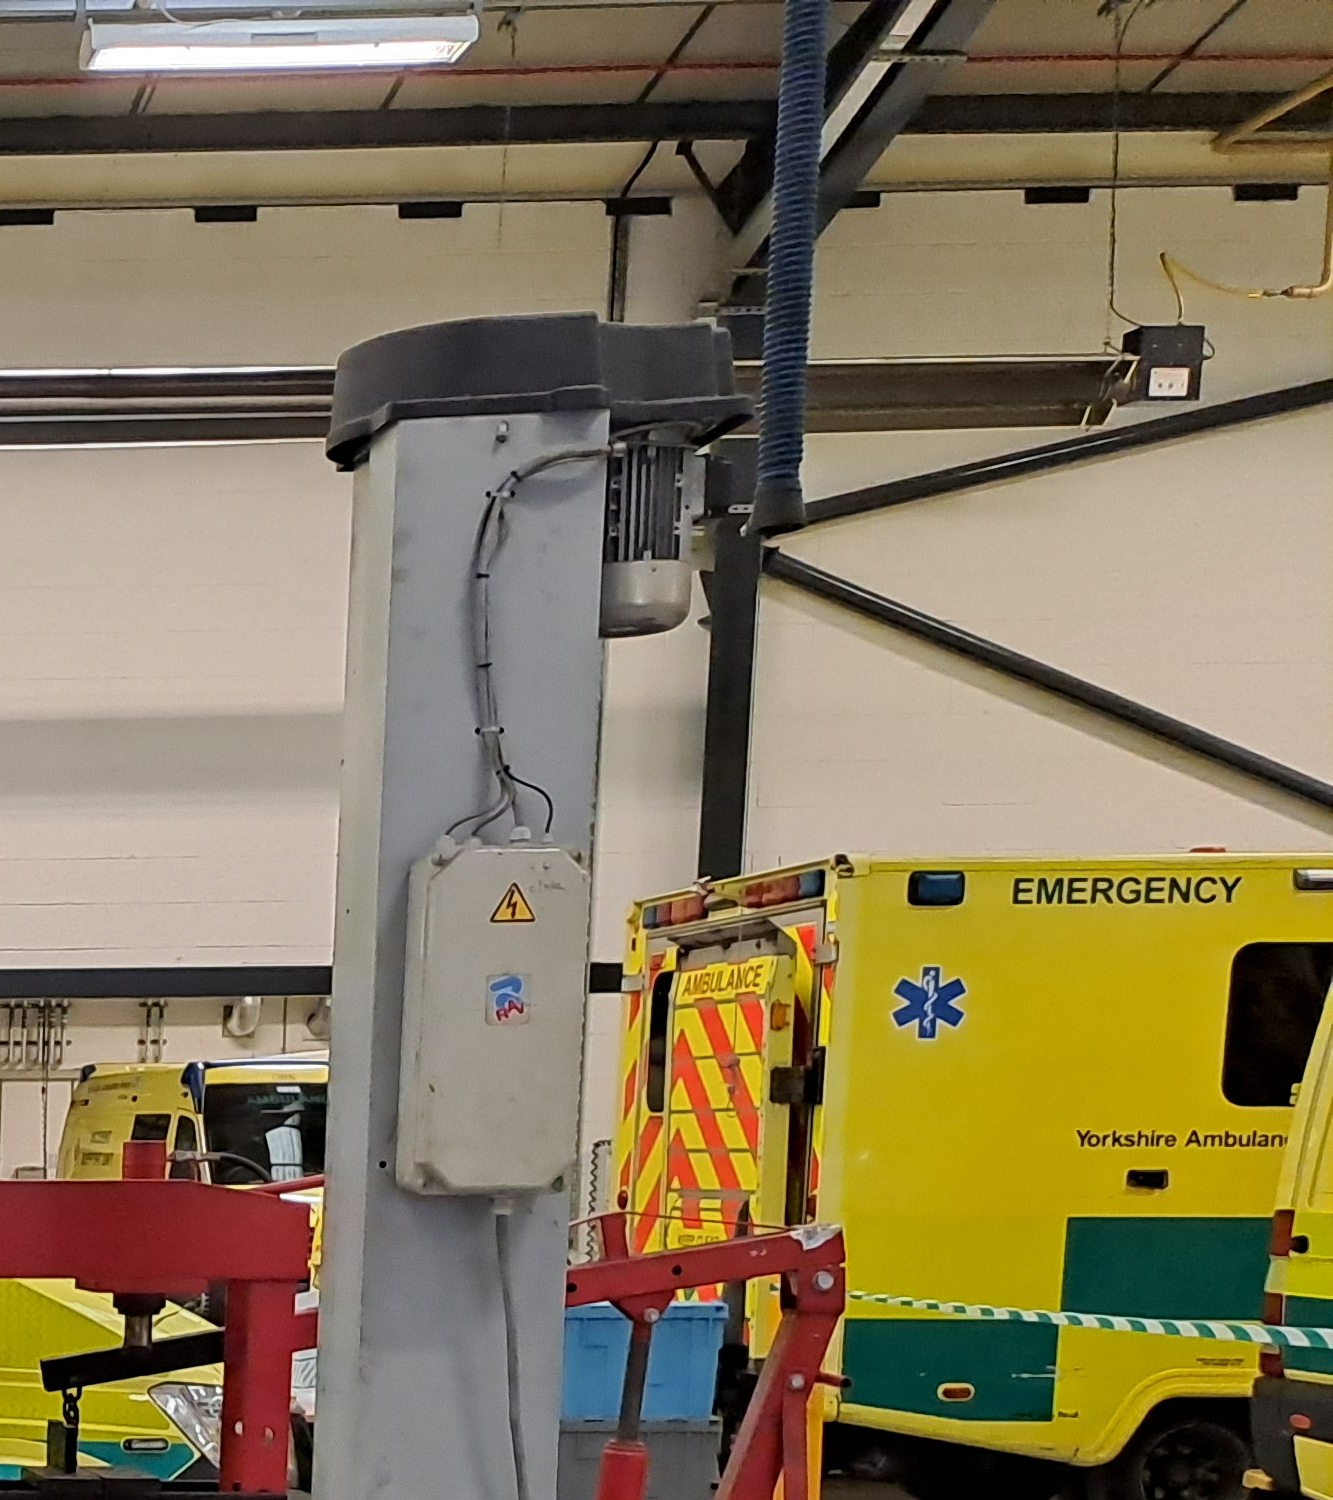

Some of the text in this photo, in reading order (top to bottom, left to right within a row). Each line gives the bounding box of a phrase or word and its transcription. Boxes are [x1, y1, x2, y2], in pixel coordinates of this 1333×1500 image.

[1012, 876, 1243, 905] EMERGENCY
[681, 964, 764, 997] AMBULANCE
[1076, 1129, 1289, 1148] Yorkshire Ambulan
